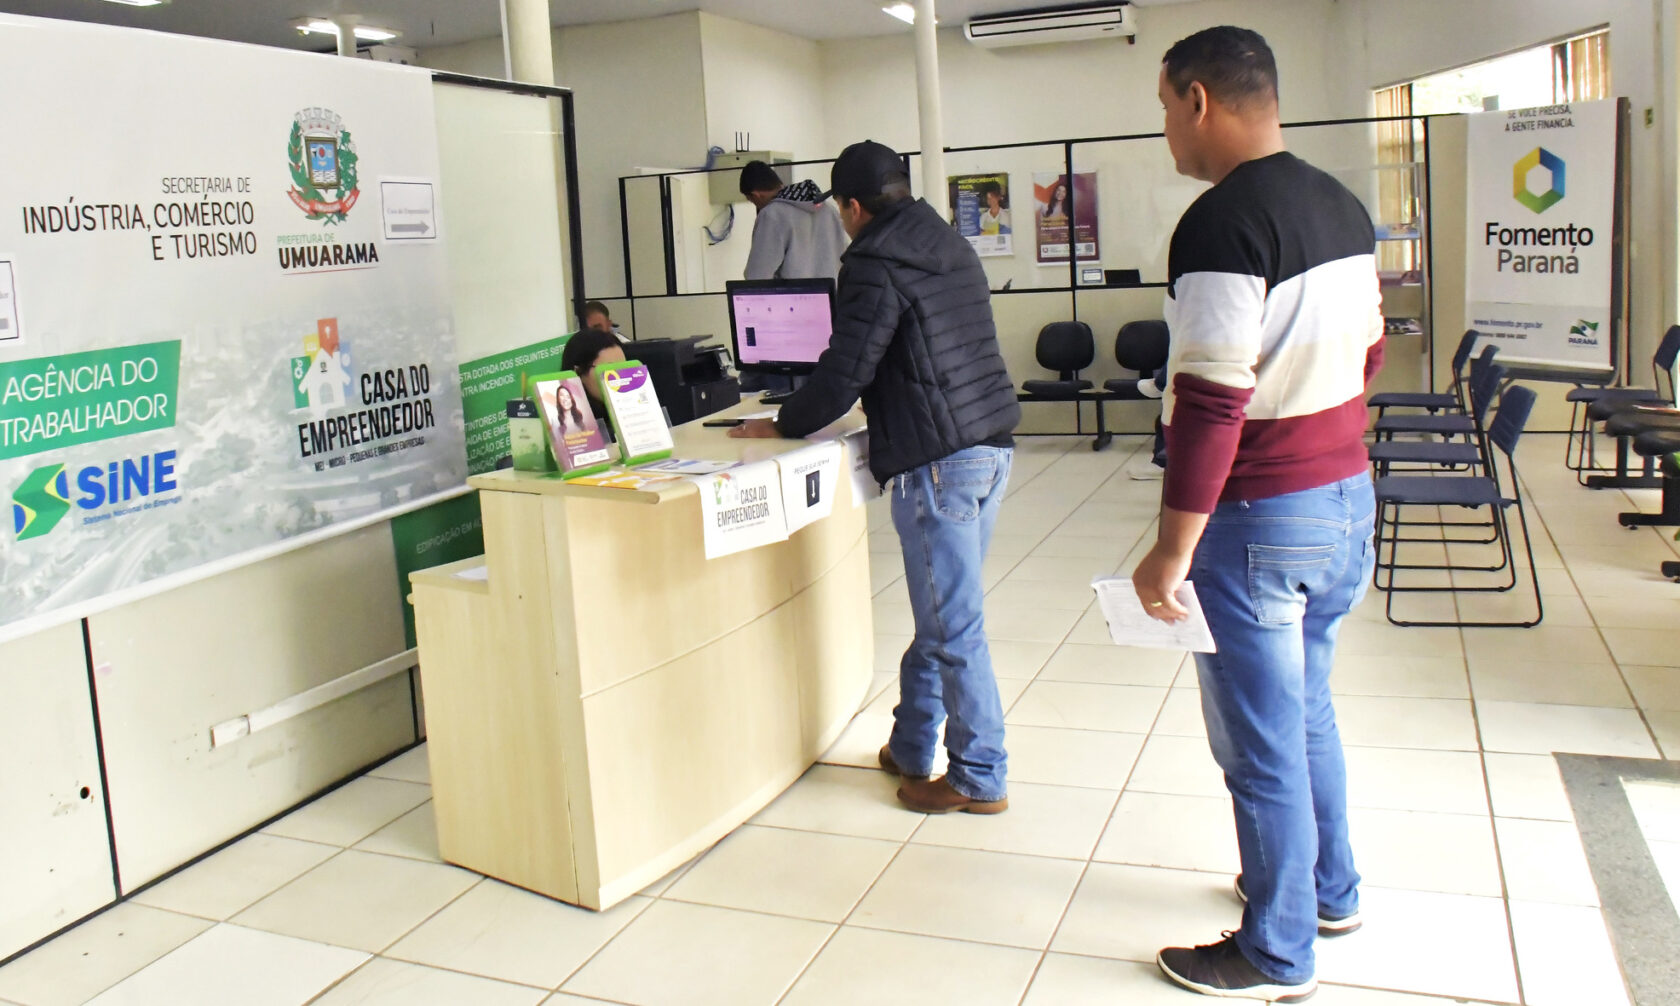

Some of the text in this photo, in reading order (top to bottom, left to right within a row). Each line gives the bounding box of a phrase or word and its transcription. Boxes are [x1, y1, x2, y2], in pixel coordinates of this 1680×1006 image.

[1505, 117, 1575, 131] A GENTE FINANCIA.
[162, 176, 251, 194] SECRETARIA DE
[23, 196, 151, 234] INDÚSTRIA,
[153, 194, 255, 228] COMÉRCIO
[152, 231, 257, 260] E TURISMO
[277, 233, 335, 245] PREFEITURA DE
[1485, 222, 1594, 247] Fomento
[278, 243, 379, 270] UMUARAMA
[1497, 247, 1580, 274] Paraná
[459, 371, 472, 383] STA
[472, 364, 499, 379] DOTADA
[500, 358, 514, 371] DOS
[515, 349, 549, 367] SEGUINTES
[2, 357, 159, 406] AGÊNCIA DO
[361, 363, 430, 405] CASA DO
[0, 393, 168, 446] TRABALHADOR
[298, 398, 435, 458] EMPREENDEDOR
[464, 413, 497, 432] TINTORES
[740, 484, 767, 505] CASA DO
[717, 502, 770, 528] EMPREENDEDOR
